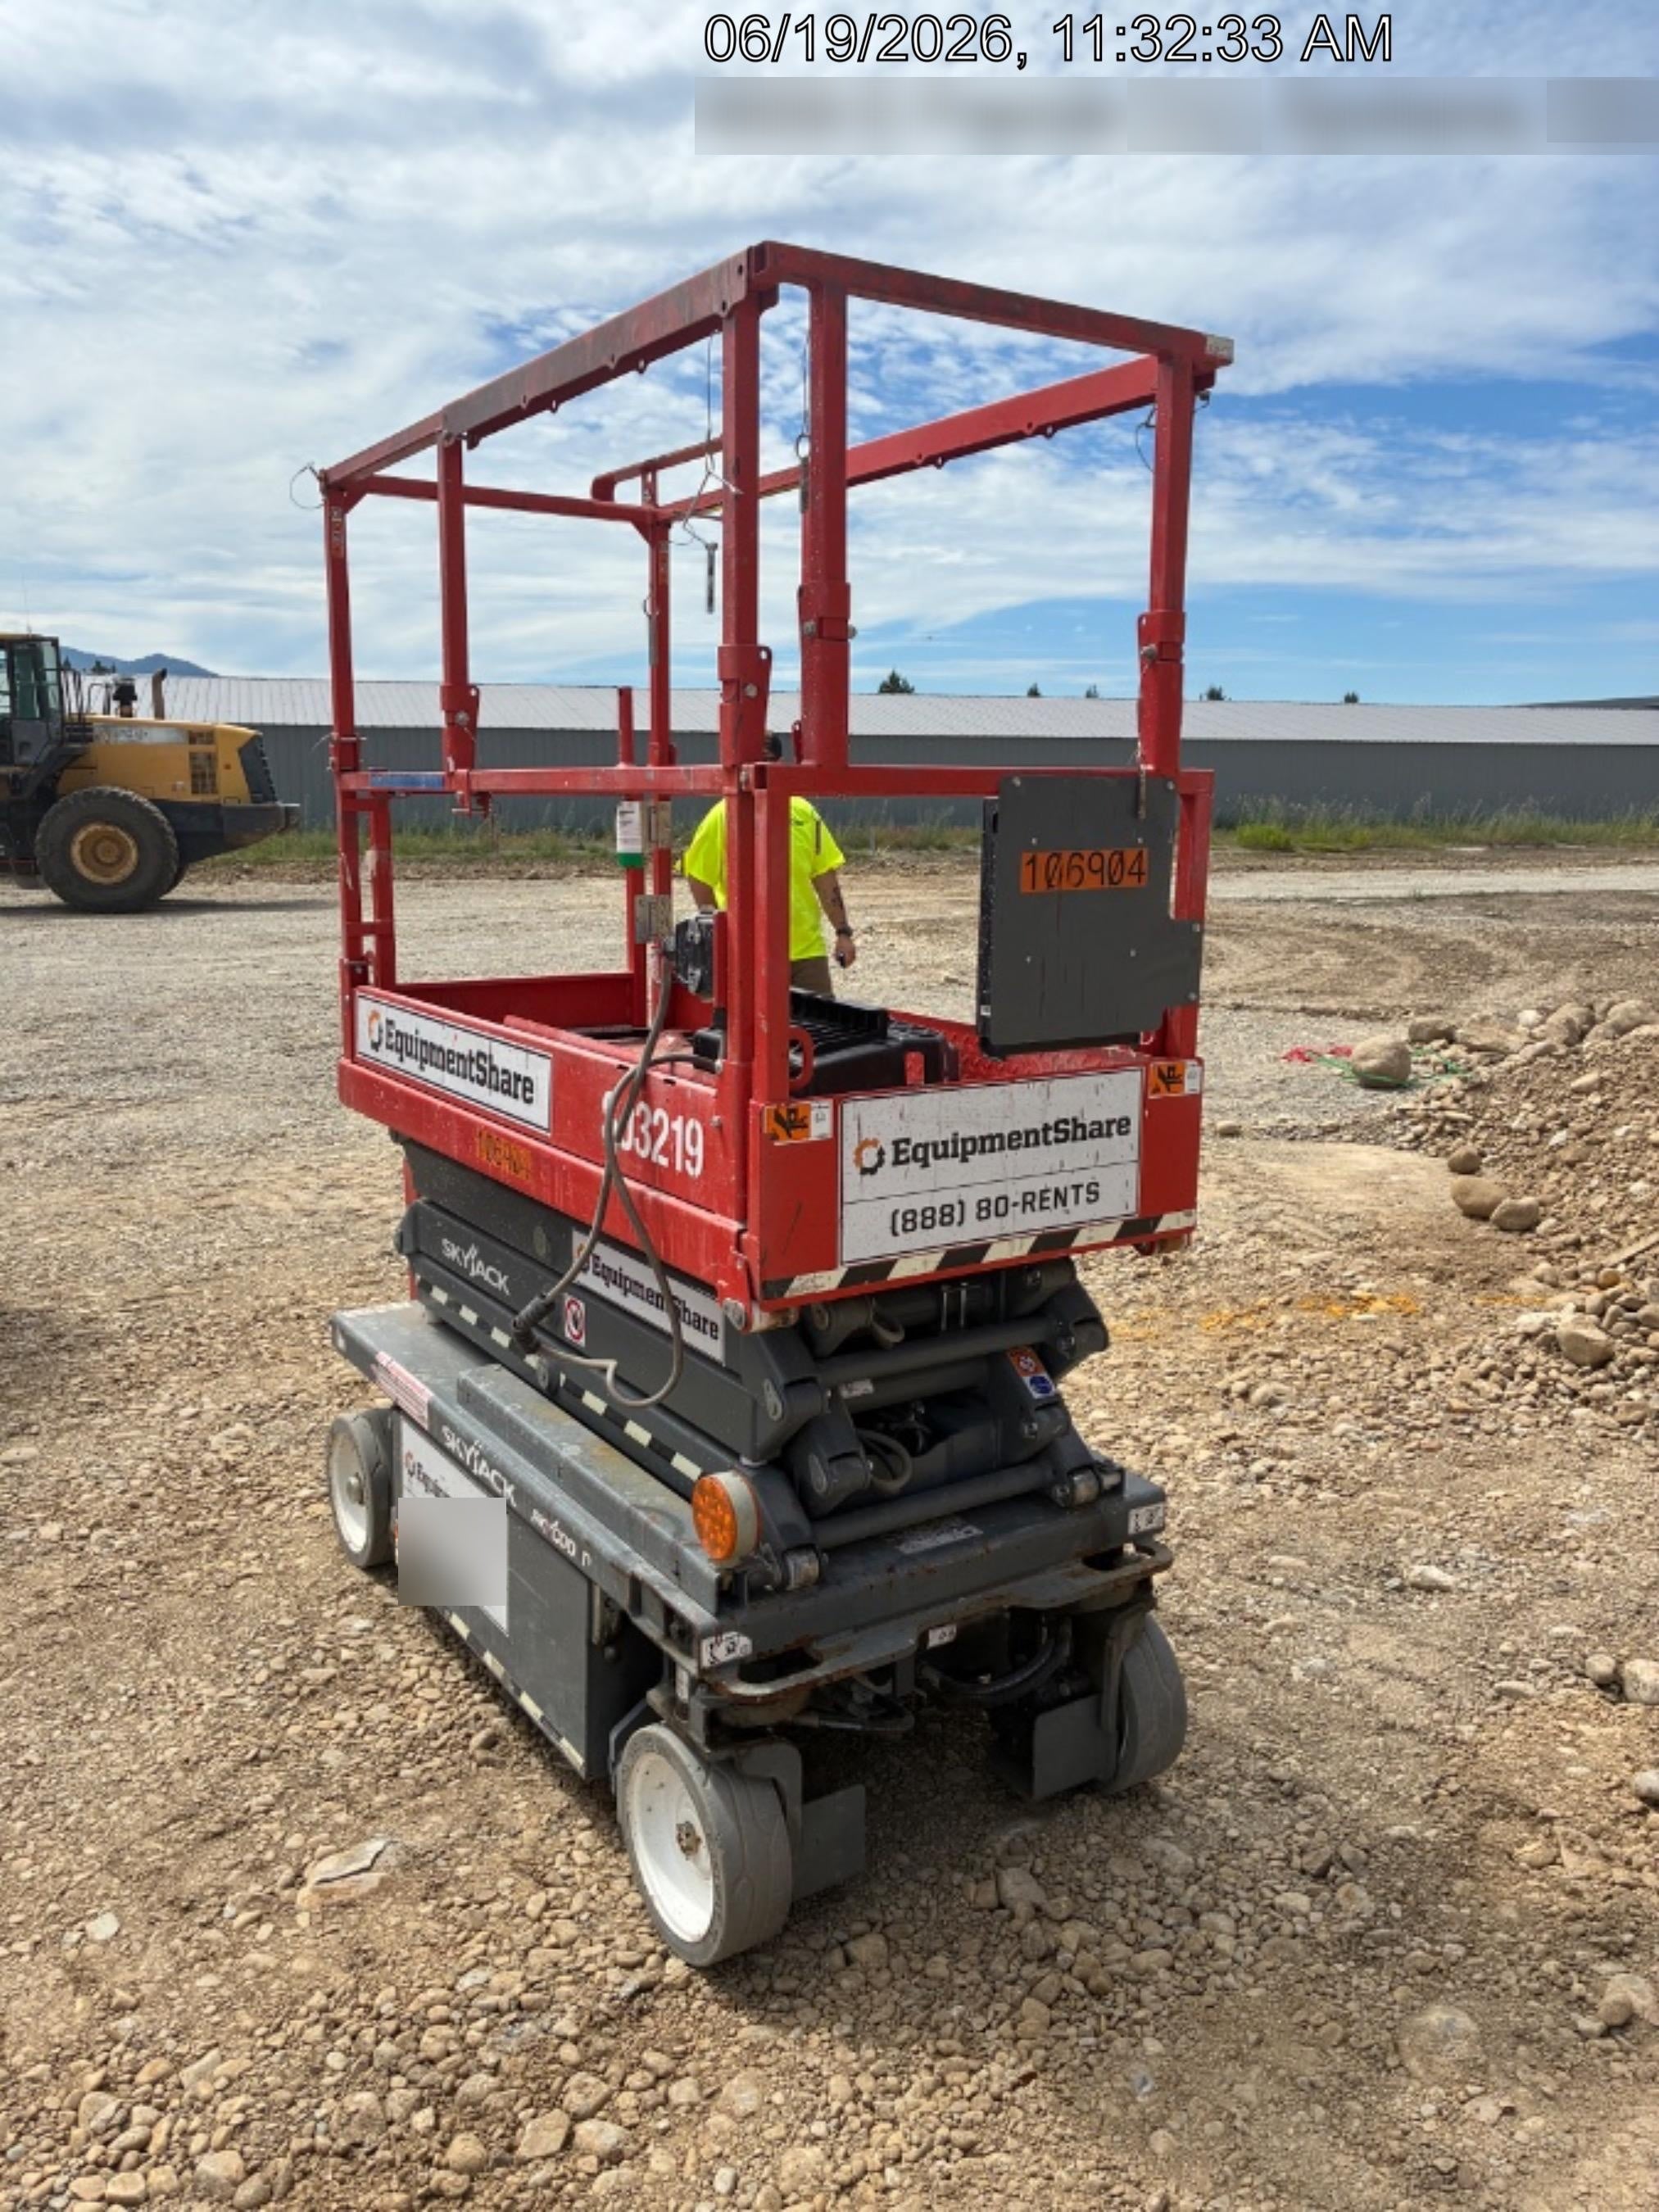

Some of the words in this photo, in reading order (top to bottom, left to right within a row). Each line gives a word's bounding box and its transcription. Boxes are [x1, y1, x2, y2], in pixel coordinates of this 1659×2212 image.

[1026, 849, 1146, 891] 106904
[384, 1018, 535, 1104] EquipmentShare
[891, 1116, 1132, 1168] EquipmentShare
[891, 1200, 965, 1236] (888)
[976, 1181, 1100, 1221] 80-RENTS
[442, 1239, 510, 1295] SKYJACK
[592, 1253, 719, 1340] EquipmenShare
[442, 1426, 517, 1507] SKYJACK
